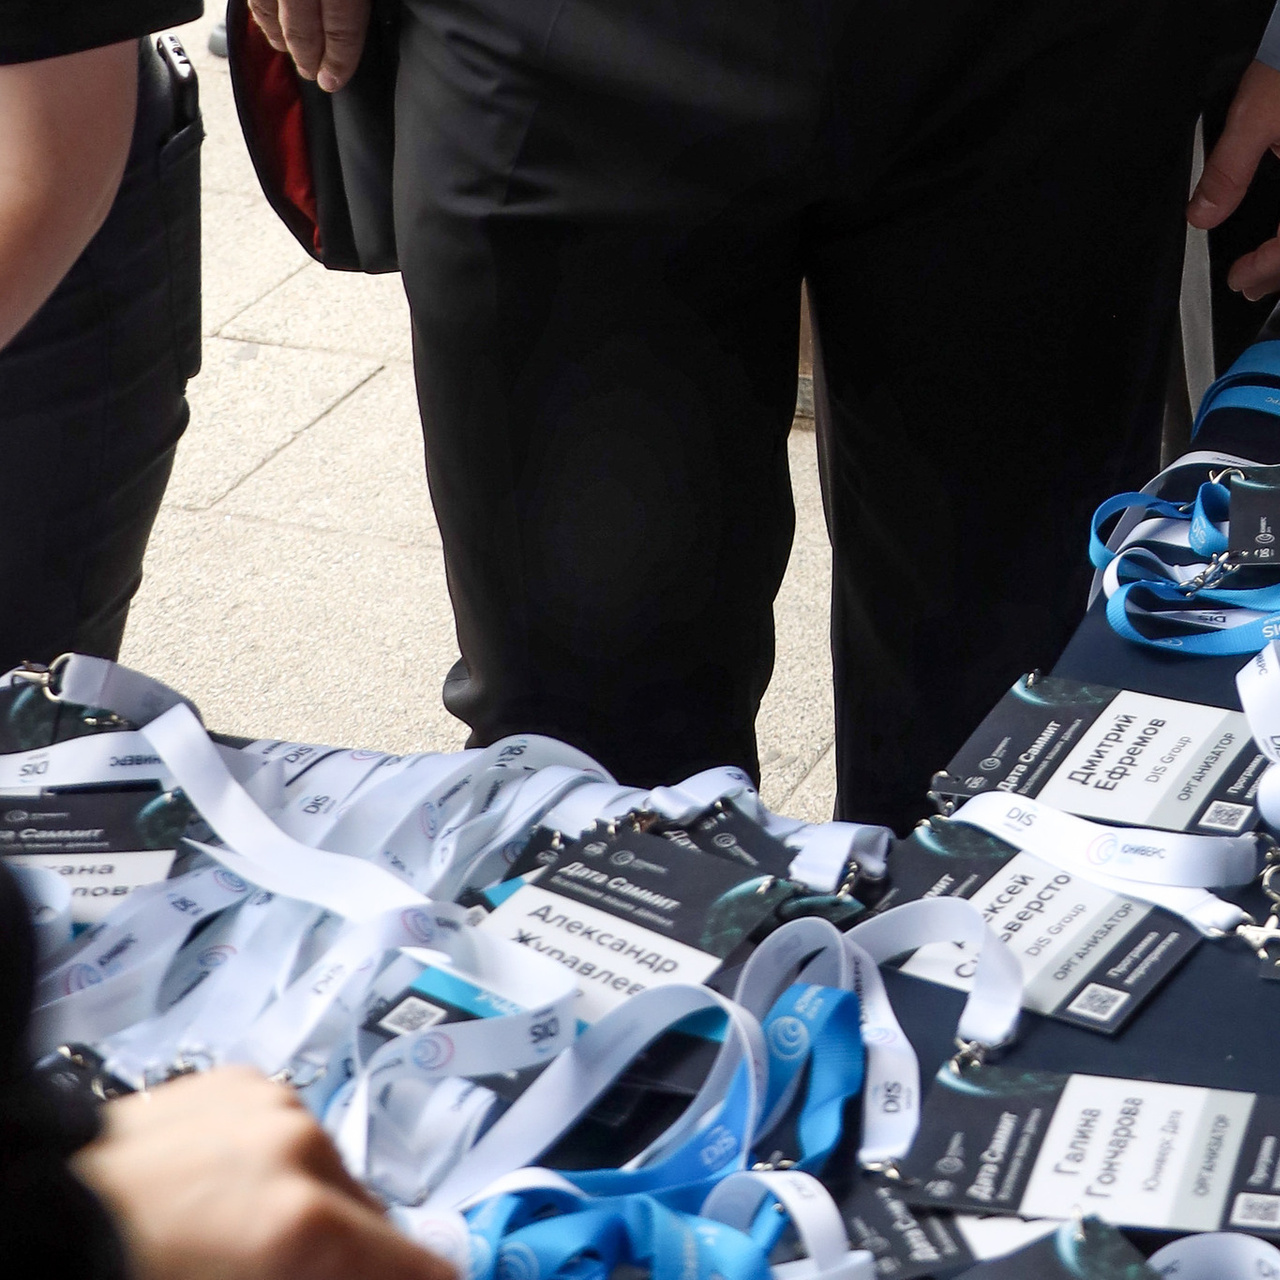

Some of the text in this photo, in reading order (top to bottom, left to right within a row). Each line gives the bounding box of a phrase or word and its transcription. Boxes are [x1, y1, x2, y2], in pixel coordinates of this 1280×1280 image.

[285, 746, 314, 764] DIS
[997, 721, 1061, 791] Дата Саммит
[1067, 714, 1137, 784] Дмитрий
[1096, 718, 1166, 790] Ефремов
[1145, 735, 1192, 783] DIS Group
[1177, 732, 1236, 801] ОРГАНИЗАТОР
[1226, 754, 1265, 794] Программа
[304, 795, 330, 815] DIS
[1006, 807, 1037, 827] DIS
[558, 861, 682, 911] Дата Саммит
[528, 905, 679, 975] Александр
[1025, 903, 1087, 957] DIS Group
[1053, 902, 1134, 981] ОРГАНИЗАТОР
[883, 1080, 902, 1113] DIS
[1054, 1107, 1101, 1176] Галина
[1085, 1097, 1144, 1199] Гончарова
[1193, 1113, 1231, 1197] ОРГАНИЗАТОР
